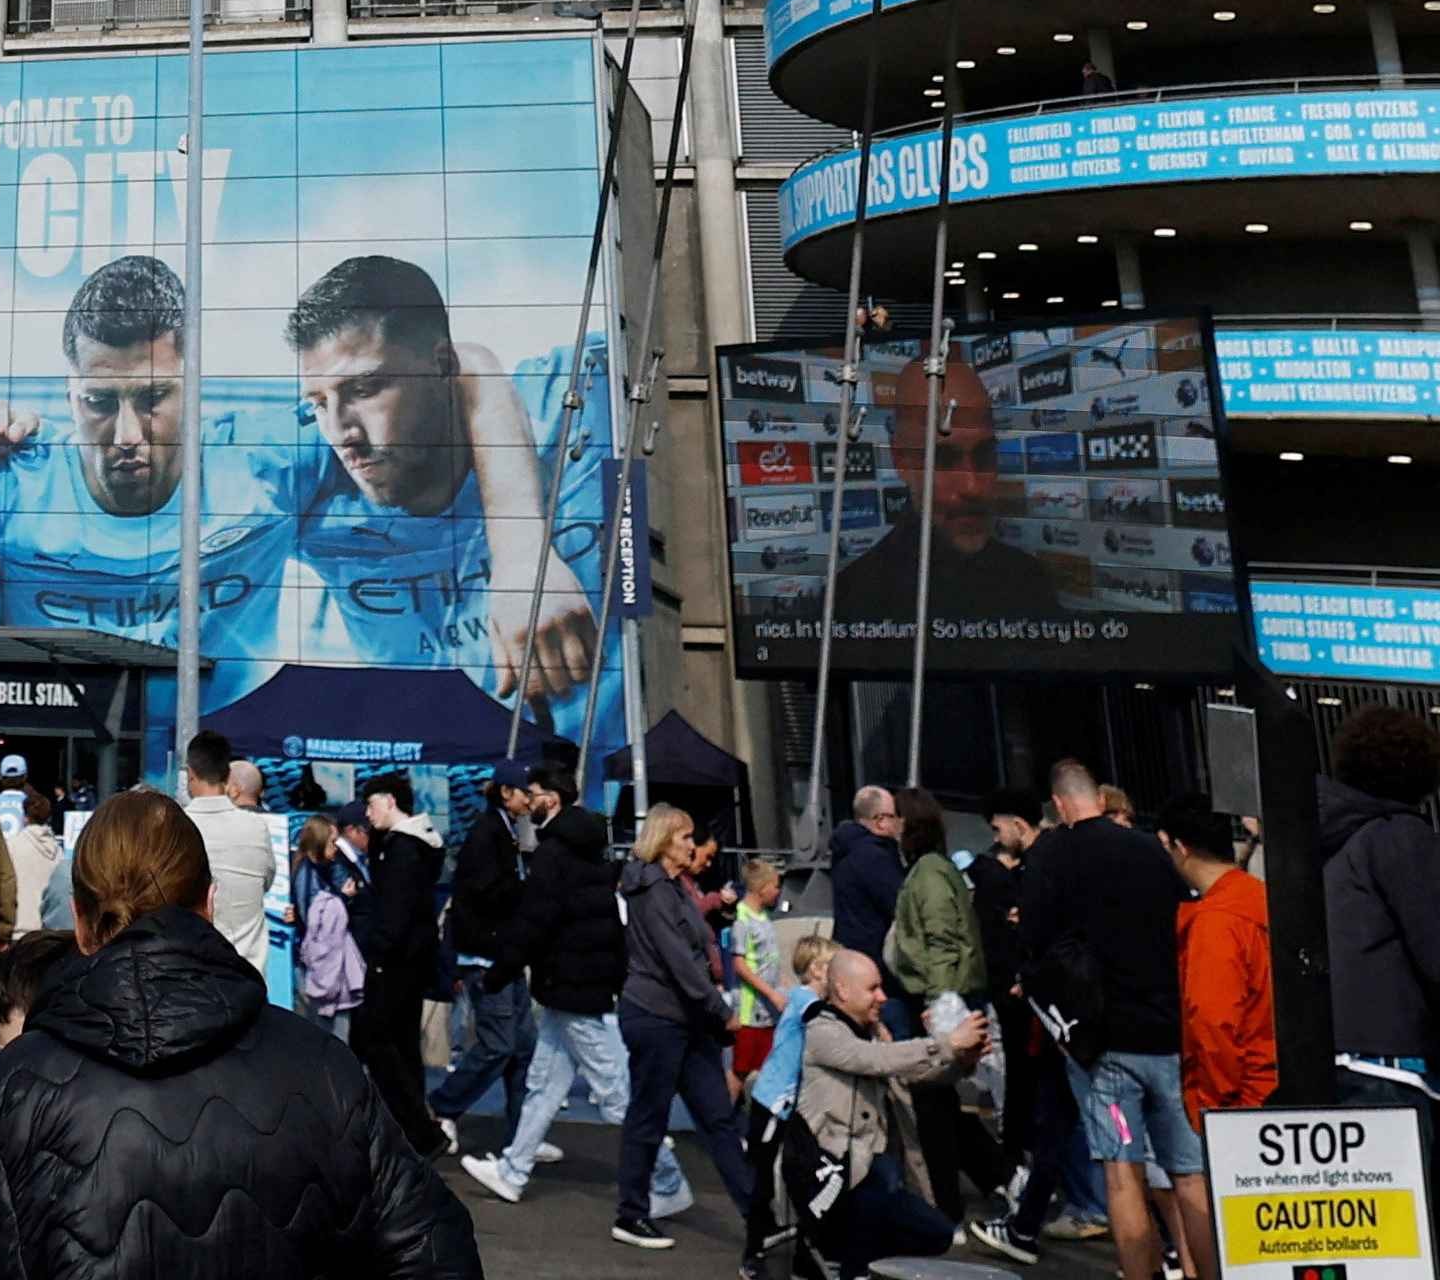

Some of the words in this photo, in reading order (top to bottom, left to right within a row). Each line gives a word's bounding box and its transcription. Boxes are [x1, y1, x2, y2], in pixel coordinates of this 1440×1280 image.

[92, 94, 135, 146] TO
[1091, 116, 1137, 135] FINLAND
[1158, 110, 1206, 129] FLIXTON
[1228, 105, 1278, 124] FRANCE
[1301, 102, 1352, 120] FRESNO
[1136, 130, 1209, 151] GLOUCESTER
[1222, 124, 1306, 146] CHELTENHAM
[1326, 144, 1359, 162] HALE
[899, 133, 989, 200] CLUBS
[16, 148, 233, 278] CITY
[1312, 338, 1361, 356] MALTA
[735, 365, 798, 392] betway
[1275, 361, 1353, 379] MIDDLETON
[1250, 383, 1297, 402] MOUNT
[746, 503, 817, 529] Revolut
[618, 518, 636, 605] RECEPTION
[848, 618, 920, 640] stadium
[931, 619, 956, 639] So
[1102, 619, 1129, 640] do
[1373, 622, 1422, 644] SOUTH
[305, 739, 391, 761] MANCHESTER
[392, 742, 423, 761] CITY
[1259, 1121, 1366, 1166] STOP
[1235, 1174, 1262, 1189] here
[1264, 1172, 1298, 1187] when
[1301, 1171, 1321, 1186] red
[1322, 1170, 1350, 1187] light
[1352, 1169, 1393, 1184] shows
[1255, 1199, 1378, 1231] CAUTION
[1258, 1239, 1325, 1255] Automatic
[1326, 1236, 1379, 1252] bollards
